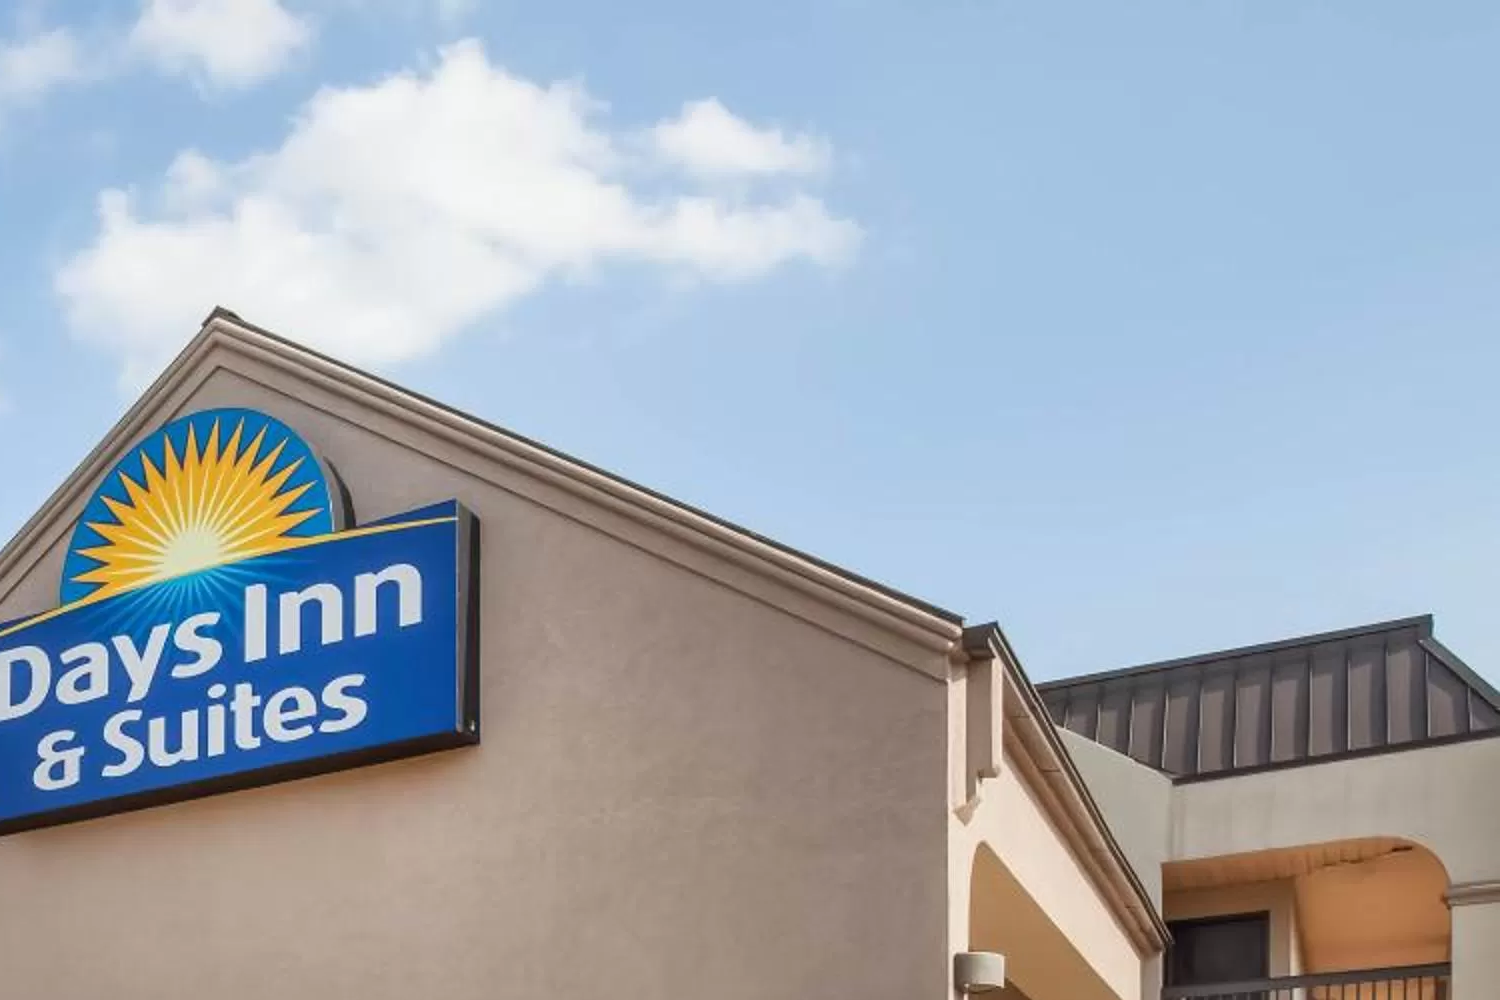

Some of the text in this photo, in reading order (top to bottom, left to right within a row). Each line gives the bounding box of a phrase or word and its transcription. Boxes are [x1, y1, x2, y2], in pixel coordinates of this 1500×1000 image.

[243, 562, 423, 664] Inn
[33, 673, 369, 791] & Suites
